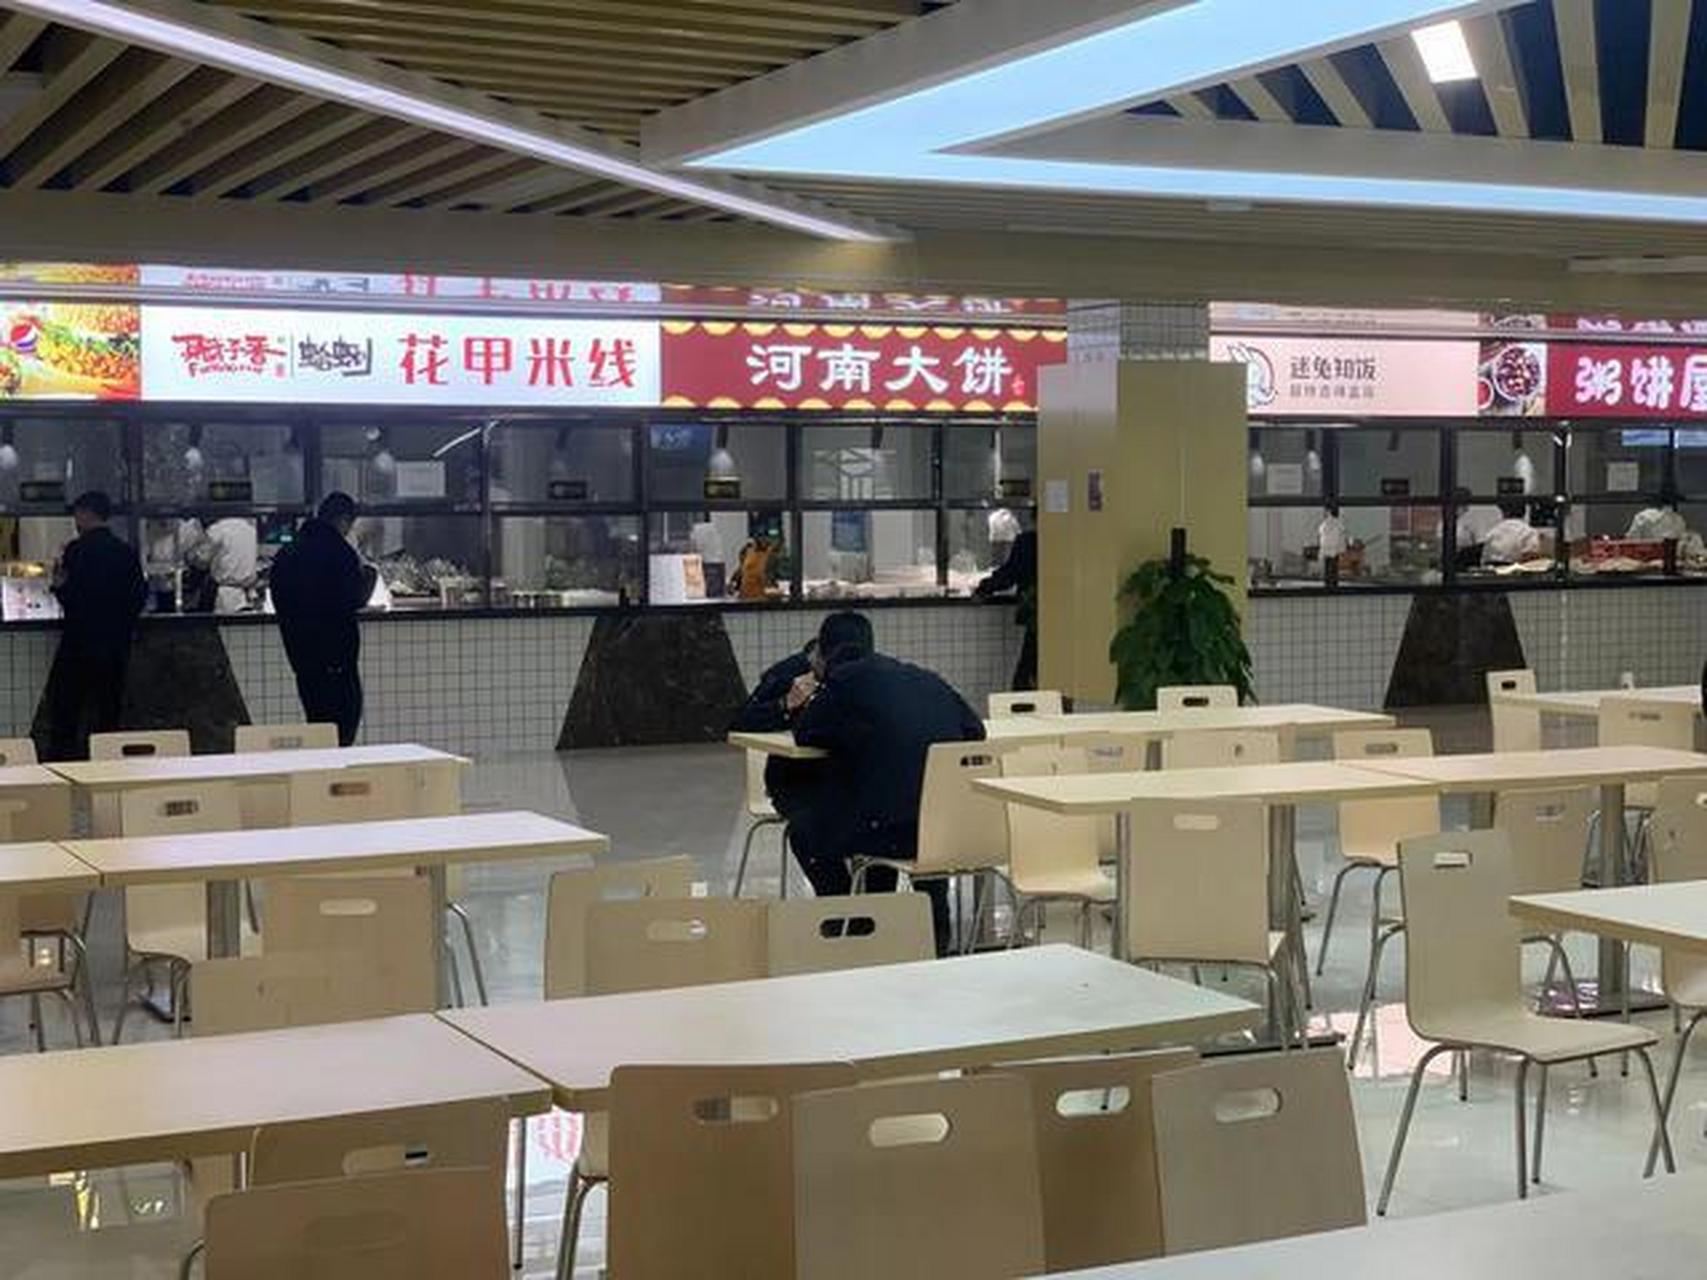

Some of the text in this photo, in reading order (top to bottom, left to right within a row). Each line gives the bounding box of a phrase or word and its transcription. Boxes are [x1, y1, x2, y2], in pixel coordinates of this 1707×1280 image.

[398, 333, 636, 388] 花甲米线
[746, 343, 1013, 396] 河南大饼
